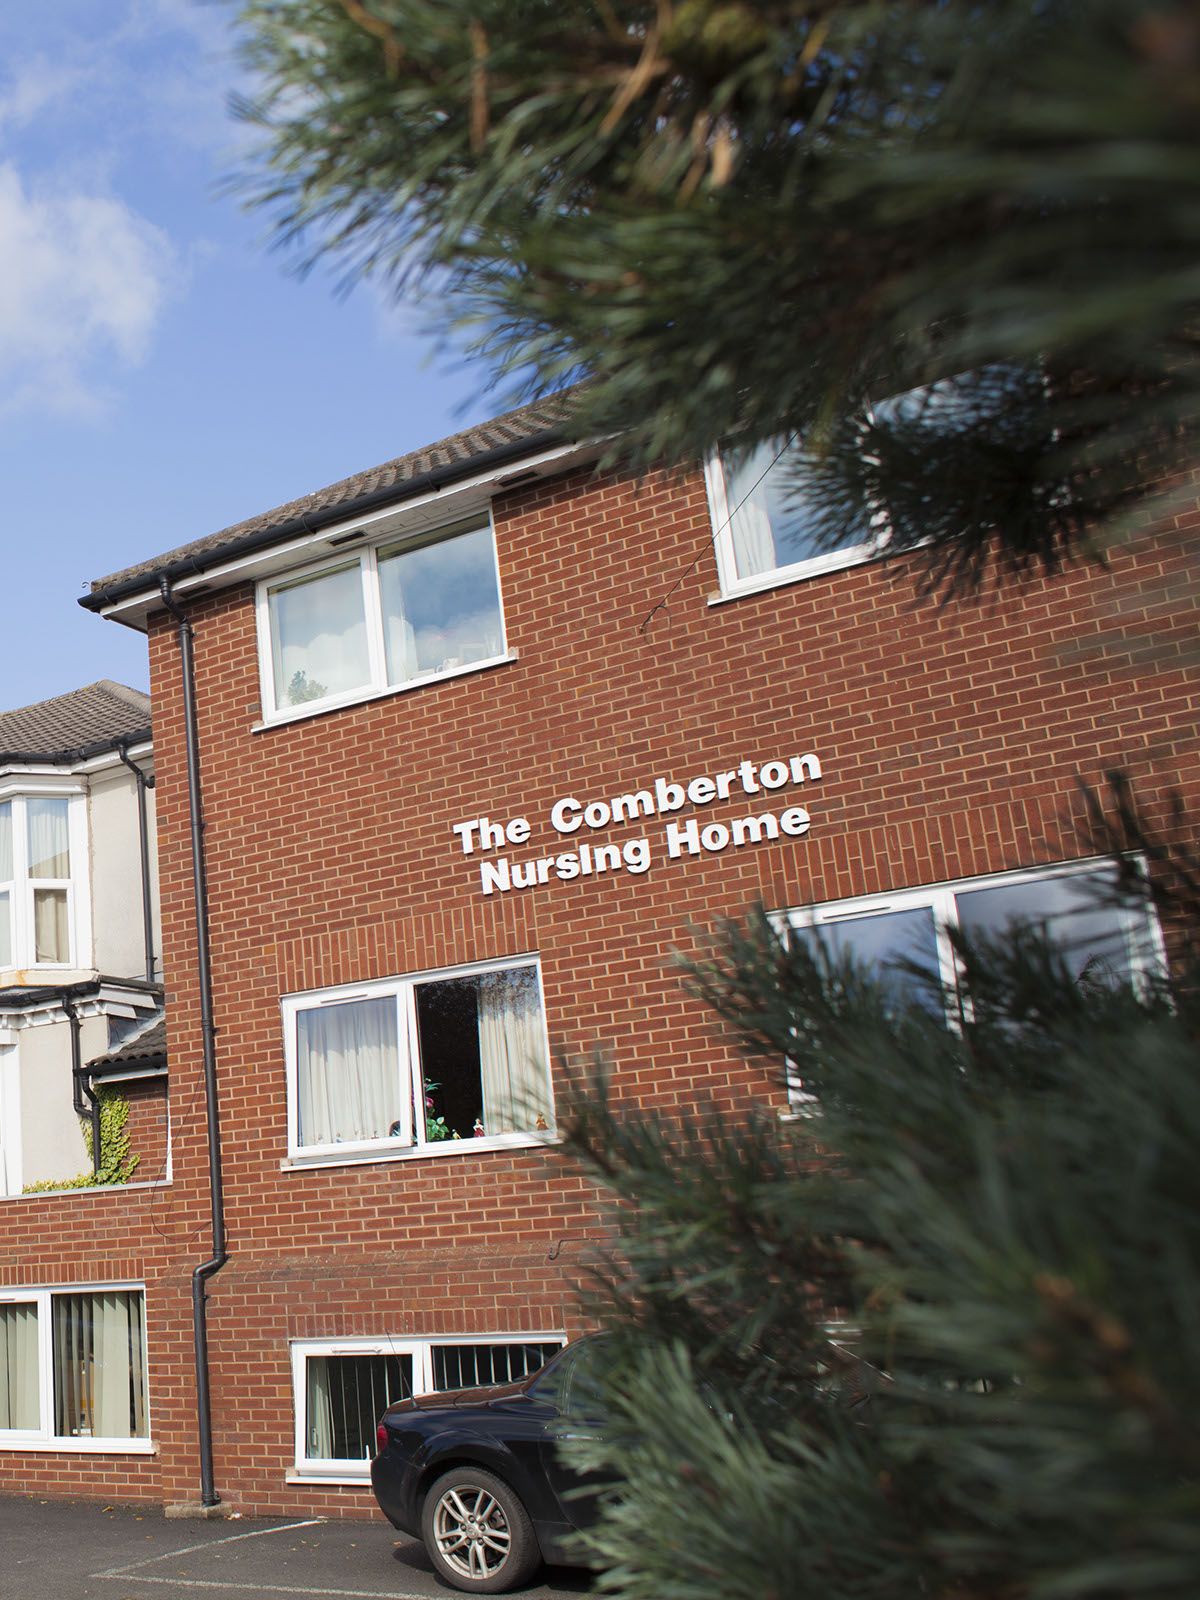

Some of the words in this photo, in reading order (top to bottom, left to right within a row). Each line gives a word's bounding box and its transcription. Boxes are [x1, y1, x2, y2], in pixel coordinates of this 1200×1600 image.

[452, 816, 531, 855] The
[551, 752, 822, 834] Comberton
[480, 838, 651, 896] Nursing
[666, 806, 811, 859] Home
